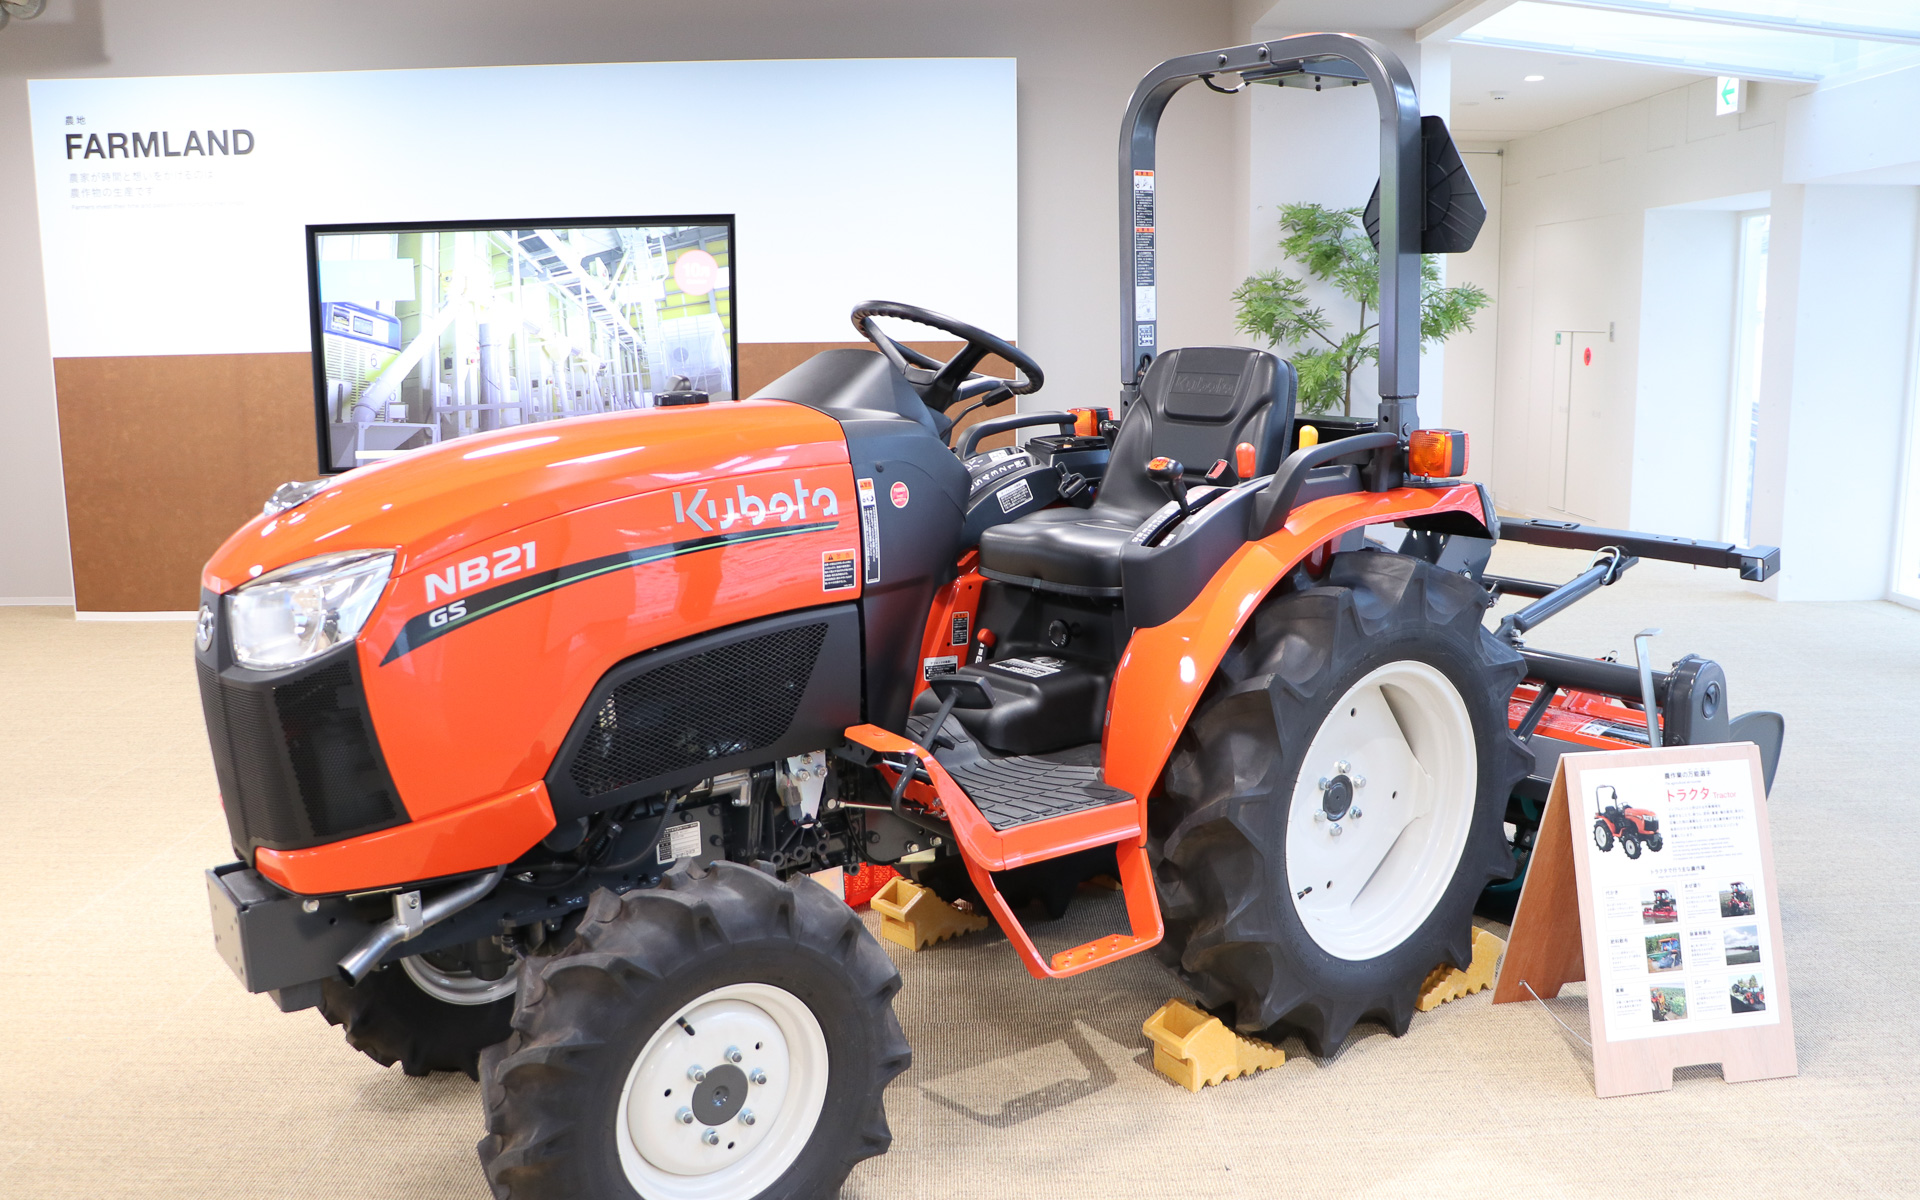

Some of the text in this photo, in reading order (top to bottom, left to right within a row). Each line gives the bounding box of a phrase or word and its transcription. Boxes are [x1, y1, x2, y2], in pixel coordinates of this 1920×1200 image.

[65, 115, 86, 126] 農地
[65, 129, 255, 160] FARMLAND
[70, 186, 154, 198] 農作物の生産です
[672, 478, 839, 531] Kubota
[424, 541, 536, 602] NB21
[428, 600, 467, 629] GS
[1667, 787, 1736, 802] トラクタ Tractor
